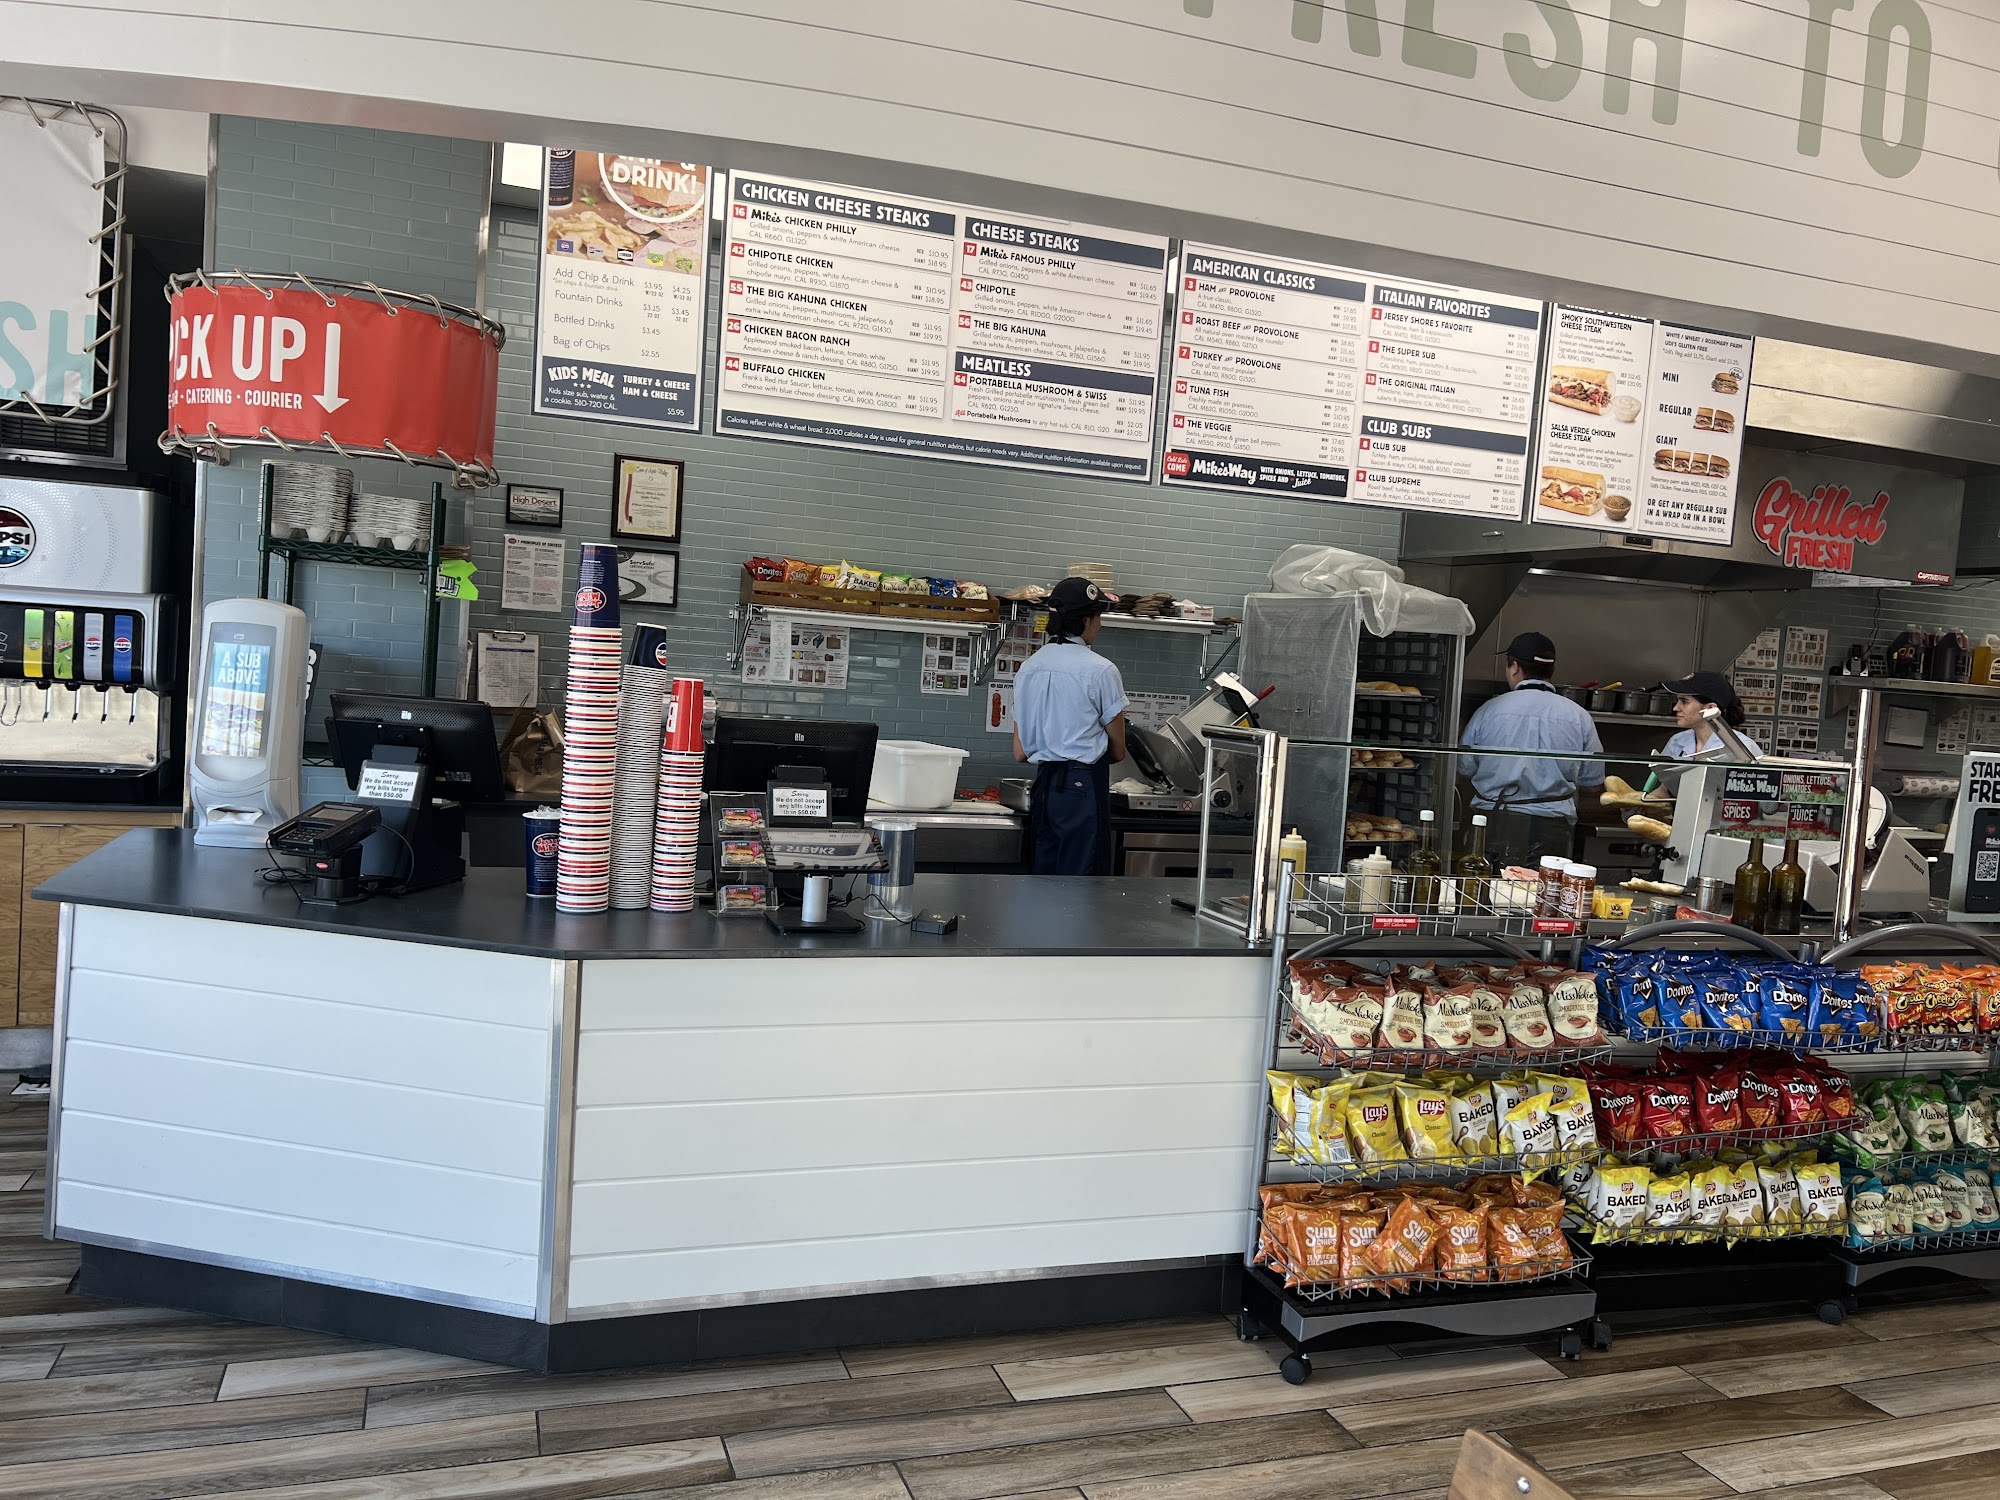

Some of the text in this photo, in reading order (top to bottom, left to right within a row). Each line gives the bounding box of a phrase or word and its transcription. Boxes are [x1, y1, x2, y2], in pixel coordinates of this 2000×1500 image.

[612, 162, 696, 194] DRINK!
[742, 183, 930, 228] CHICKEN CHEESE STEAKS
[735, 206, 857, 235] 16 Mike's CHICKEN PHILLY
[972, 223, 1080, 252] CHEESE STEAKS
[965, 244, 1076, 270] 17 Mike's FAMOUS PHILLY
[555, 268, 634, 287] Add Chip & Drink
[1193, 259, 1315, 290] AMERICAN CLASSICS
[644, 282, 690, 294] $3.95 $4.25
[1188, 281, 1193, 289] 3
[1199, 283, 1216, 292] HAM
[1230, 288, 1275, 302] PROVOLONE
[555, 290, 592, 303] Fountain
[596, 295, 623, 307] Drinks
[672, 308, 689, 316] $3.45
[730, 282, 867, 312] 55 THE BIG KAHUNA CHICKEN
[1380, 290, 1490, 318] ITALIAN FAVORITES
[232, 314, 306, 382] UP
[553, 336, 660, 358] Bag of Chips $2.55
[727, 359, 825, 380] 44 BUFFALO CHICKEN
[962, 356, 1031, 377] MEATLESS
[548, 366, 615, 388] KIDS MEAL
[623, 375, 652, 387] TURKEY
[663, 381, 690, 391] CHEESE
[1367, 375, 1455, 394] 13 THE ORIGINAL ITALIAN
[1662, 372, 1679, 382] MINI
[623, 387, 677, 400] HAM & CHEESE
[955, 375, 1107, 401] 64 PORTABELLA MUSHROOM & SWISS
[186, 388, 232, 404] CATERING
[245, 390, 302, 409] COURIER
[667, 408, 684, 416] $5.95
[1659, 403, 1691, 417] REGULAR
[1174, 417, 1231, 432] 14 THE VEGGIE
[1367, 420, 1431, 439] CLUB SUBS
[1551, 424, 1615, 439] SALSA VERDE CHICKEN
[1551, 432, 1592, 443] CHEESE STEAK
[1656, 436, 1677, 446] GIANT
[1167, 463, 1186, 473] COME
[1369, 474, 1385, 483] CLUB
[1388, 476, 1421, 486] SUPREME
[513, 495, 556, 507] High Desert
[1648, 498, 1727, 515] OR GET ANY REGULAR SUB
[1647, 508, 1654, 516] IN
[1662, 510, 1680, 519] WRAP
[1682, 512, 1691, 520] OR
[1693, 513, 1700, 521] IN
[1702, 514, 1707, 522] A
[1708, 515, 1725, 525] BOWL
[1754, 478, 1889, 554] Grilled
[1785, 536, 1854, 569] FRESH
[758, 567, 783, 577] Doritos
[854, 578, 877, 589] BAKED
[222, 652, 261, 668] A SUB
[218, 667, 261, 685] ABOVE.
[1726, 779, 1778, 798] Mike's Way
[1724, 806, 1751, 818] SPICES
[1666, 984, 1694, 999] Doritos
[1706, 993, 1738, 1004] Doritos
[1822, 995, 1852, 1009] Doritos
[1741, 1078, 1779, 1097] Doritos
[1419, 1100, 1445, 1116] Lay's
[1601, 1095, 1634, 1109] Doritos
[1365, 1106, 1388, 1122] Lay's
[1459, 1103, 1493, 1123] BAKED
[1770, 1182, 1798, 1194] BAKED
[1808, 1187, 1843, 1199] BAKED
[1608, 1196, 1646, 1206] BAKED
[1305, 1226, 1338, 1247] Sun
[1451, 1226, 1478, 1247] Sun
